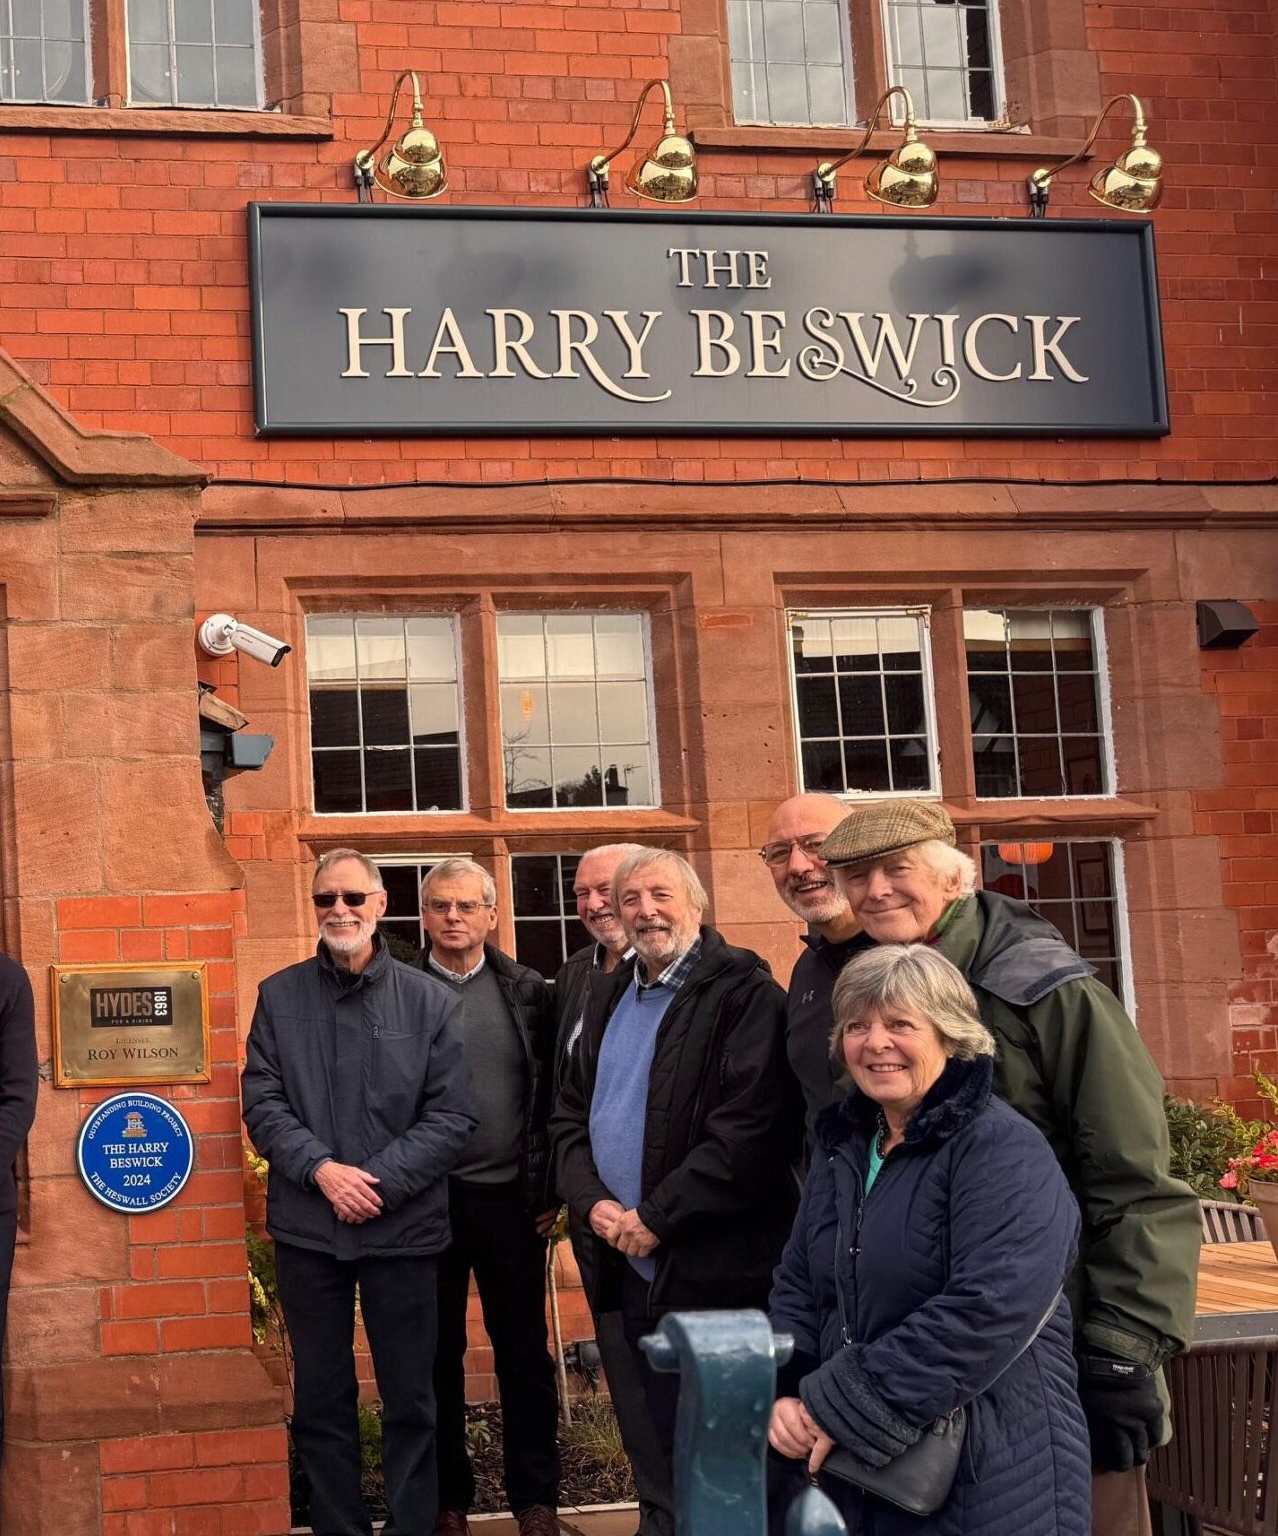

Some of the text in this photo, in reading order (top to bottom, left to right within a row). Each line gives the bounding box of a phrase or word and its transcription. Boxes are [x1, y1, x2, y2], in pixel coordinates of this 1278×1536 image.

[668, 248, 772, 289] THE
[338, 306, 1090, 407] HARRY BESWICK
[96, 992, 153, 1018] HYDES
[154, 991, 168, 1016] 1863
[88, 1047, 178, 1060] ROY WILSON
[88, 1099, 183, 1140] OUTSTANDING BUILDING PROJECT
[102, 1142, 169, 1155] THE HARRY
[110, 1156, 163, 1169] BESWICK
[91, 1171, 182, 1206] THE HESWALL SOCIETY
[123, 1174, 151, 1187] 2024
